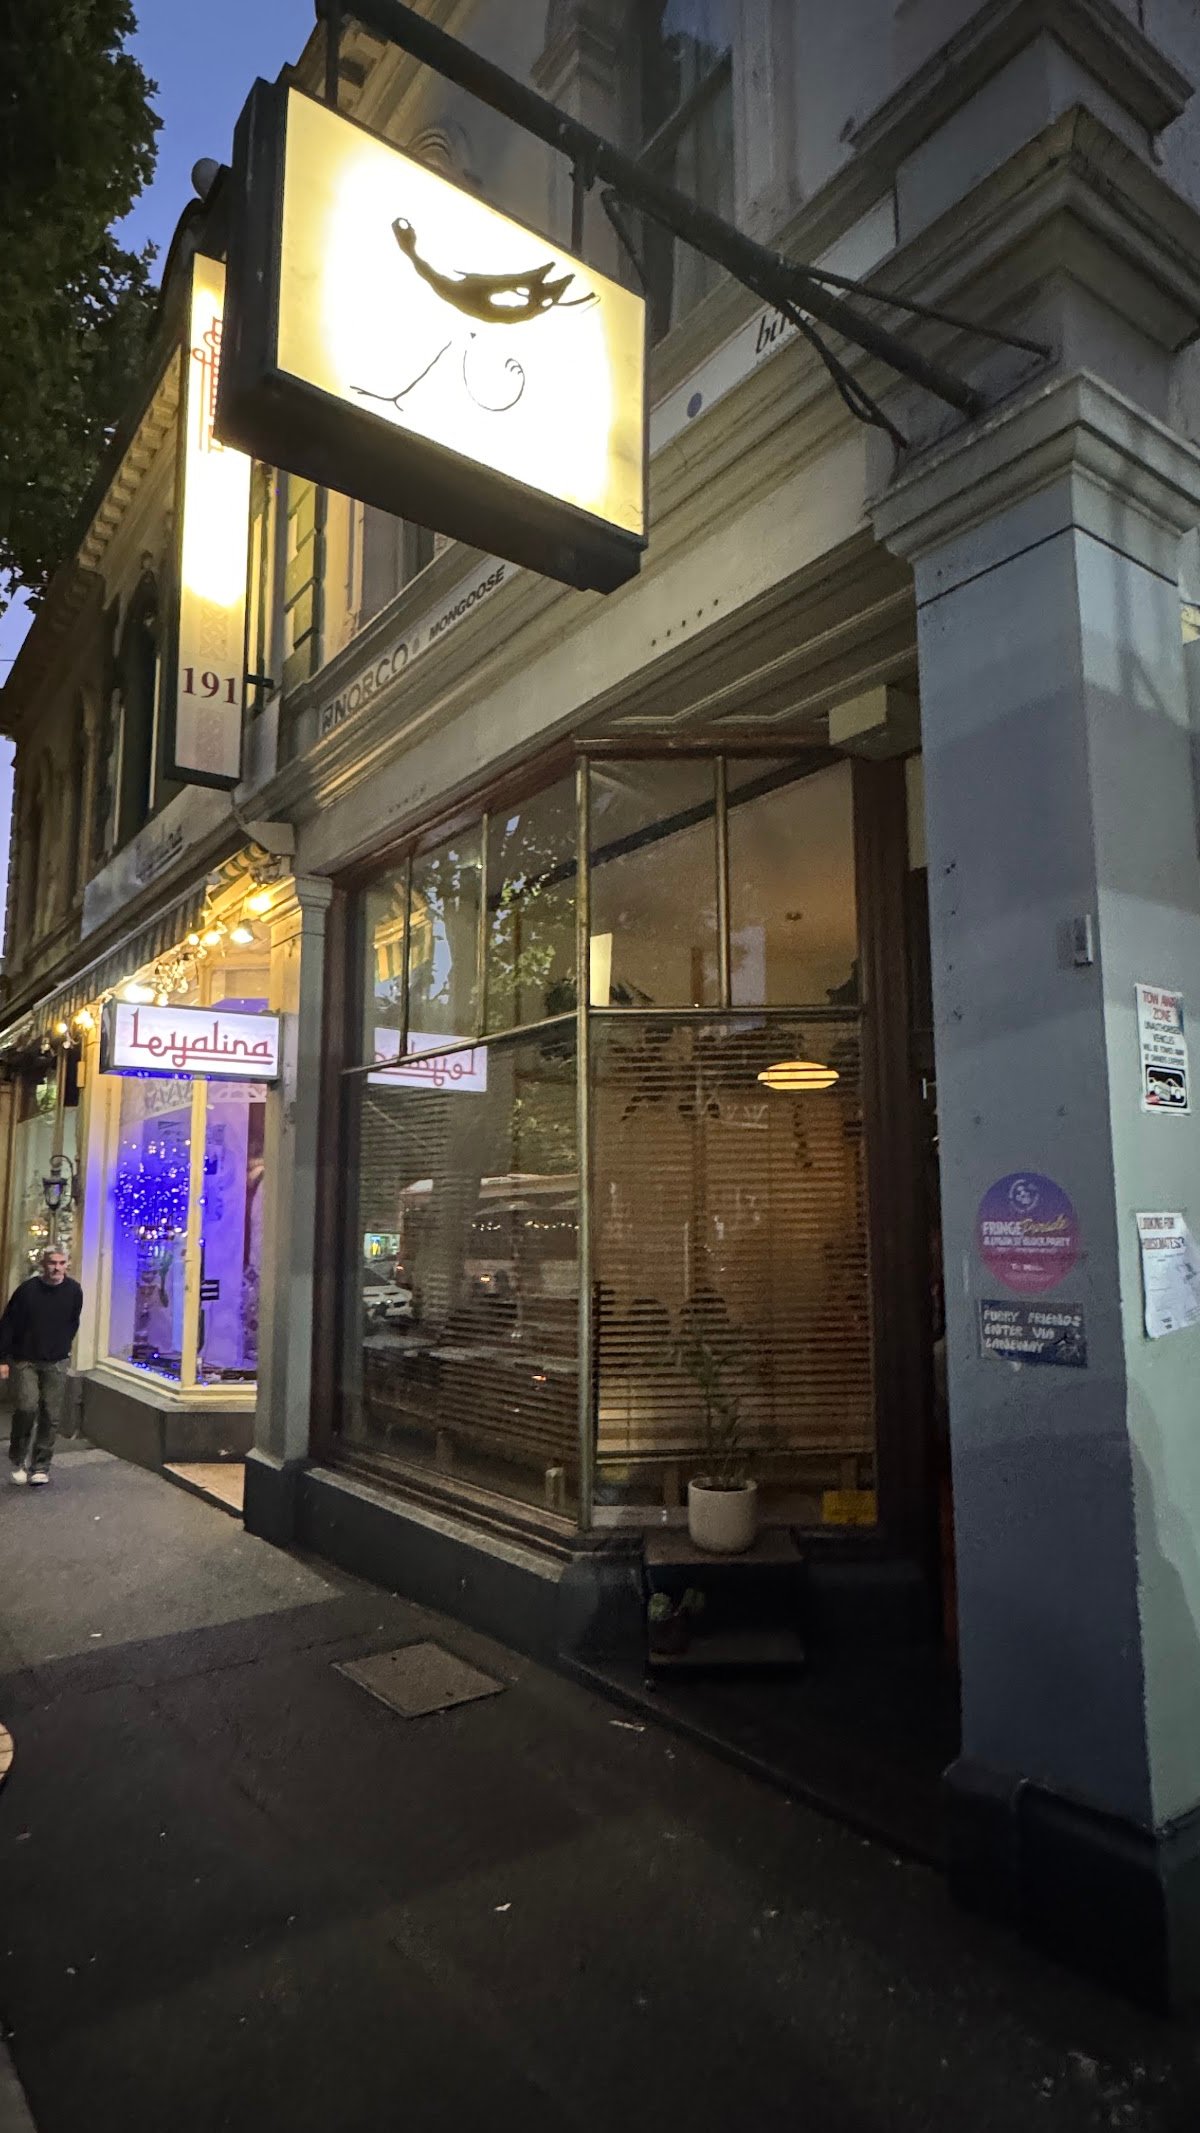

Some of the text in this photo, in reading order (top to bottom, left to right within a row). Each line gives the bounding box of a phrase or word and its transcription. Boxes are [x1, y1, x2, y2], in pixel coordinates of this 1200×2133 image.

[334, 564, 506, 724] NORCO MONGOOSE
[182, 667, 239, 706] 191
[130, 1008, 274, 1068] Leyalina
[982, 1221, 1022, 1236] FRINGE
[983, 1309, 1082, 1327] FURRY FRIENDS
[983, 1323, 1055, 1340] ENTER VIA
